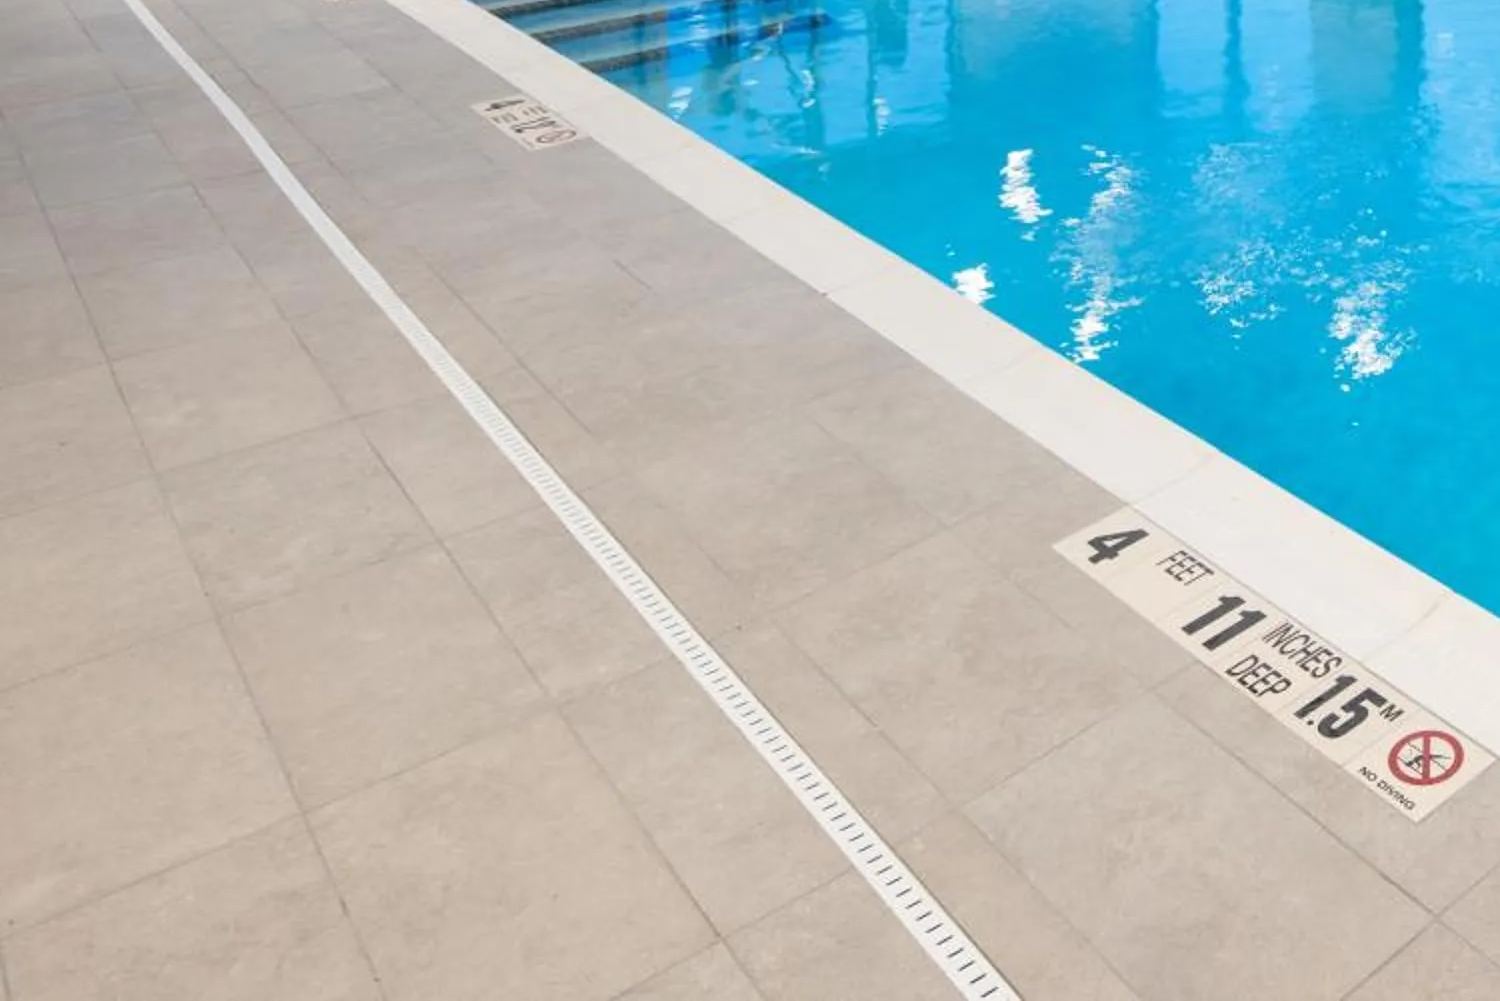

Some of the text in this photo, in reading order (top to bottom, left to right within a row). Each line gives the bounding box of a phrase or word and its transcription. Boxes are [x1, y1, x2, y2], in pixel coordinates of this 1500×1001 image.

[1087, 528, 1150, 565] 4
[1154, 550, 1215, 586] FEET
[1181, 595, 1267, 652] 11
[1262, 622, 1344, 679] INCHES
[1225, 654, 1292, 698] DEEP
[1358, 766, 1416, 810] NO DIVING
